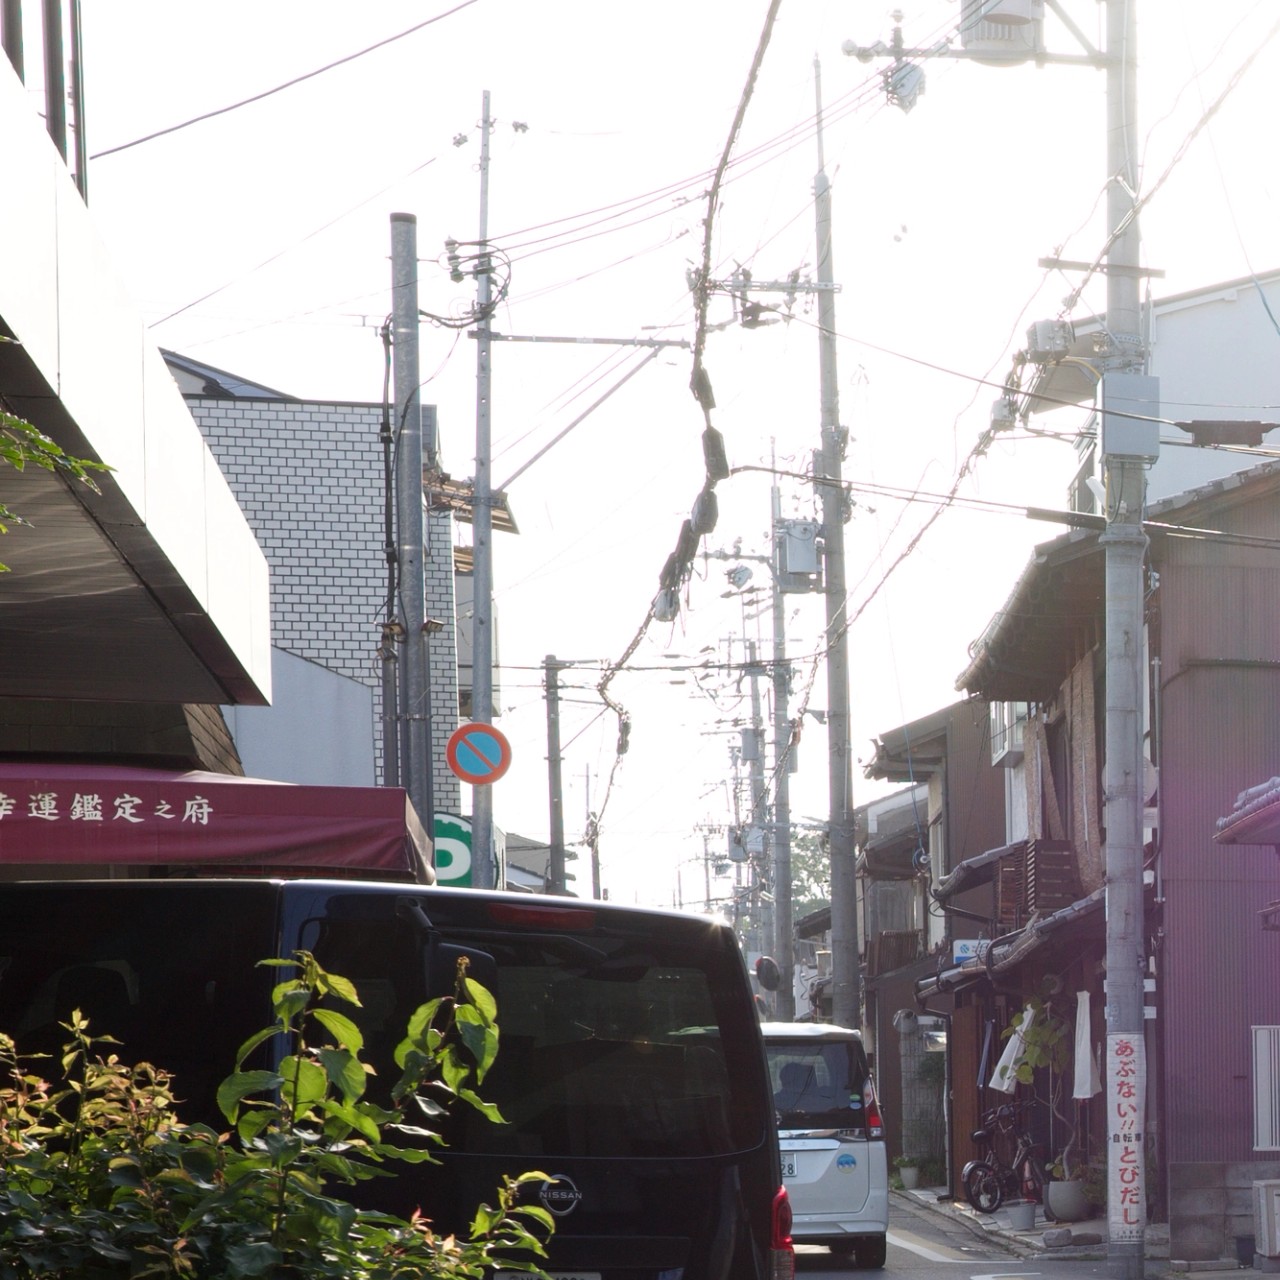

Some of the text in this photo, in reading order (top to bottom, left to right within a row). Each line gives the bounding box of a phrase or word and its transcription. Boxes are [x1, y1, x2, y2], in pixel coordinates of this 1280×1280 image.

[539, 1190, 583, 1200] NISSAN
[1119, 1146, 1140, 1226] とびだし
